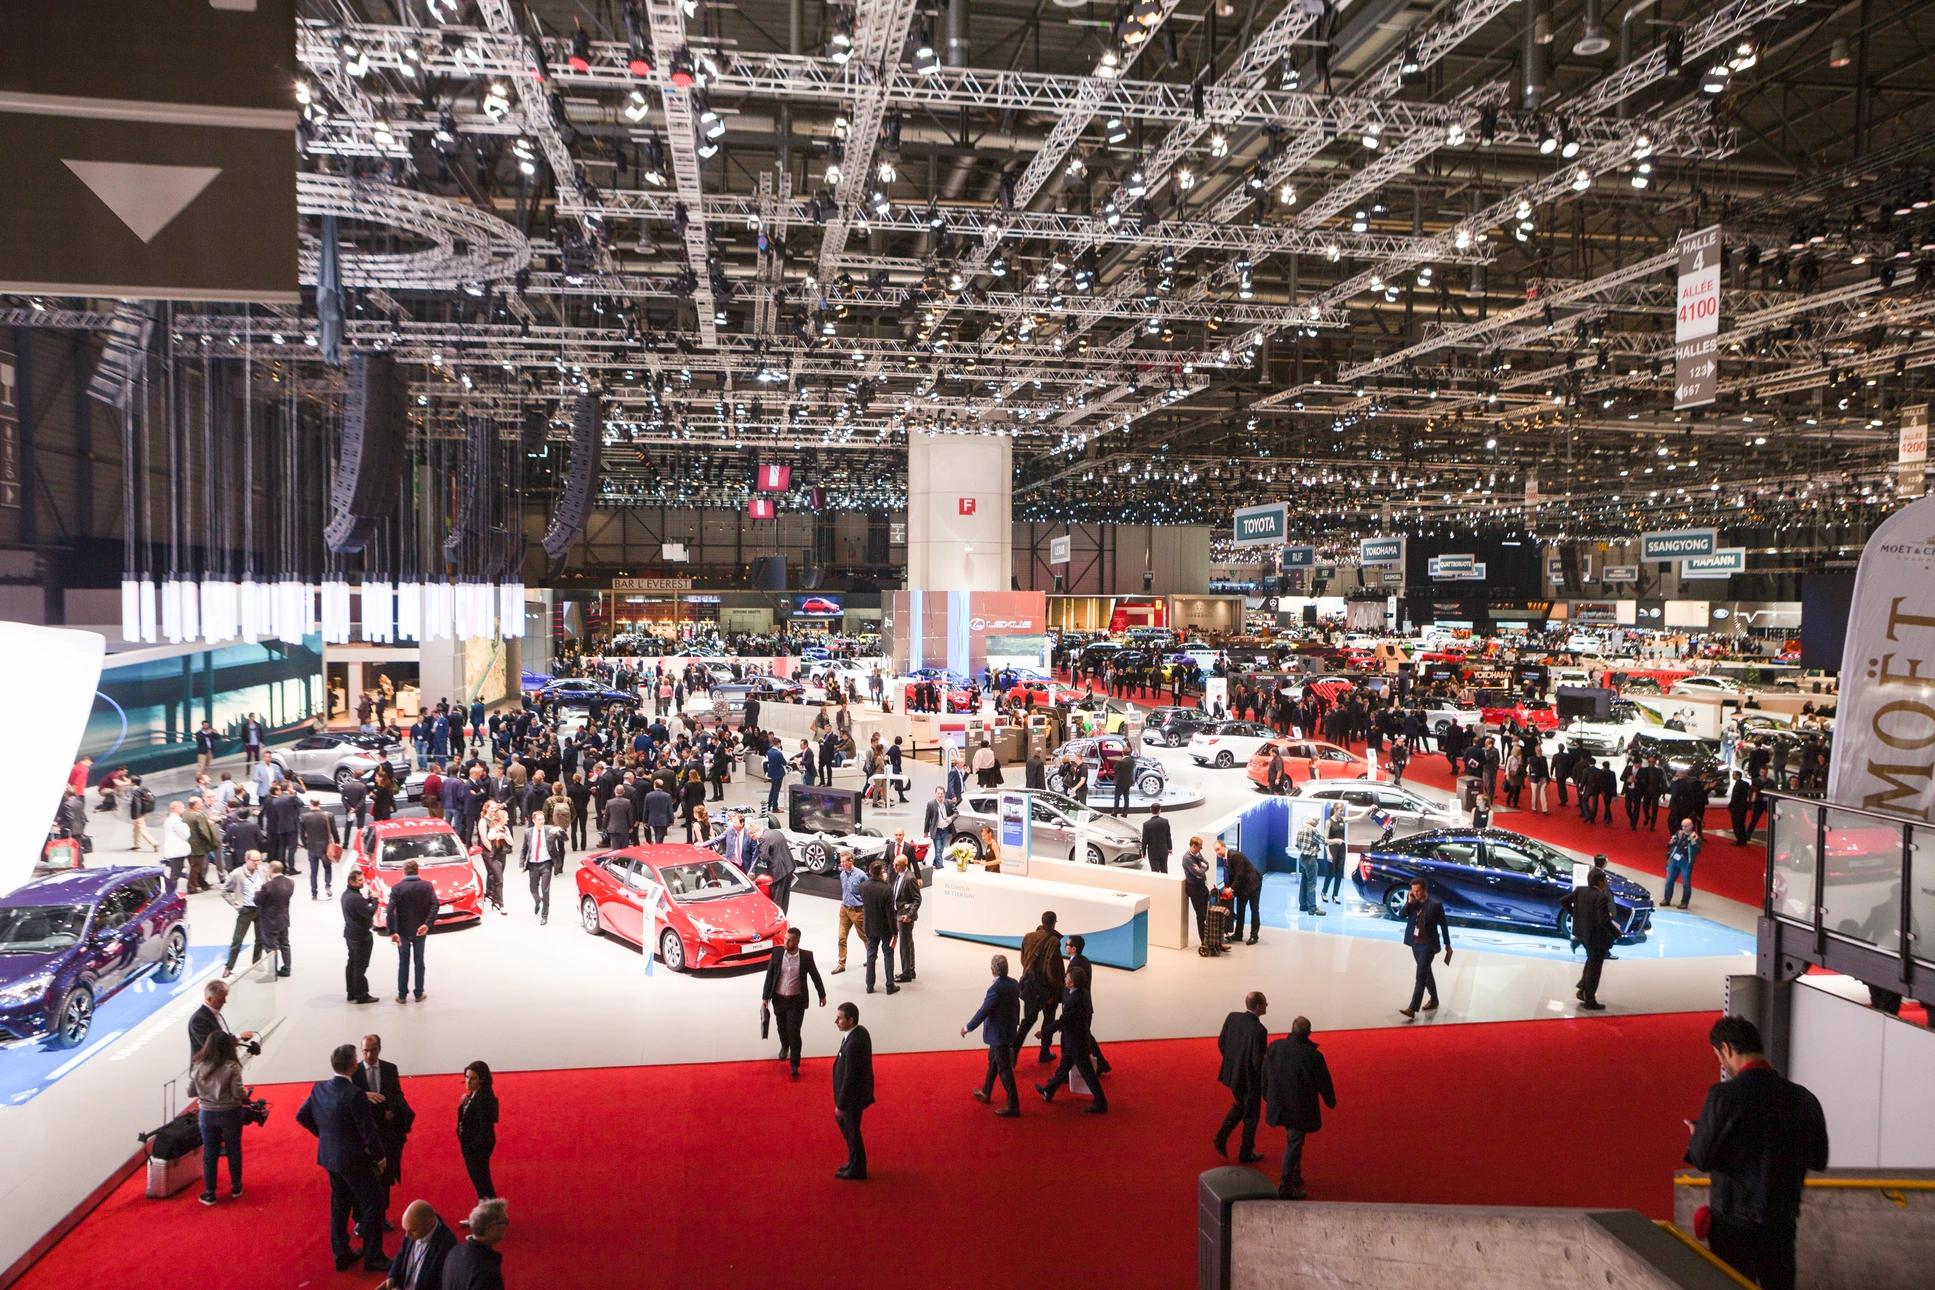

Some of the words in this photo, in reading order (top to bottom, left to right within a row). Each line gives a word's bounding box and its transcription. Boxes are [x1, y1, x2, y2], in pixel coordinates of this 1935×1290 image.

[1682, 231, 1717, 255] HALLE
[1692, 249, 1704, 271] 4
[1682, 279, 1714, 300] ALLÉE
[1678, 296, 1717, 324] 4100
[1676, 338, 1718, 361] HALLES
[1689, 364, 1707, 379] 123
[1683, 383, 1701, 398] 567
[1903, 407, 1926, 417] HALLE
[1910, 415, 1918, 427] 4
[1901, 441, 1926, 453] 4200
[1899, 462, 1925, 472] HALLES
[963, 499, 972, 512] F
[1243, 516, 1276, 534] TOYOTA
[1365, 545, 1397, 556] YOKOHAMA
[1648, 538, 1709, 552] SSANGYONG
[1880, 545, 1912, 554] MOËT
[1291, 552, 1303, 562] RUF
[614, 579, 634, 589] BAR
[646, 579, 690, 589] EVEREST
[986, 620, 1032, 628] LEXUS
[1473, 671, 1512, 679] YOKOHAMA
[1863, 595, 1935, 822] MOËT
[944, 883, 965, 891] ALWAYS
